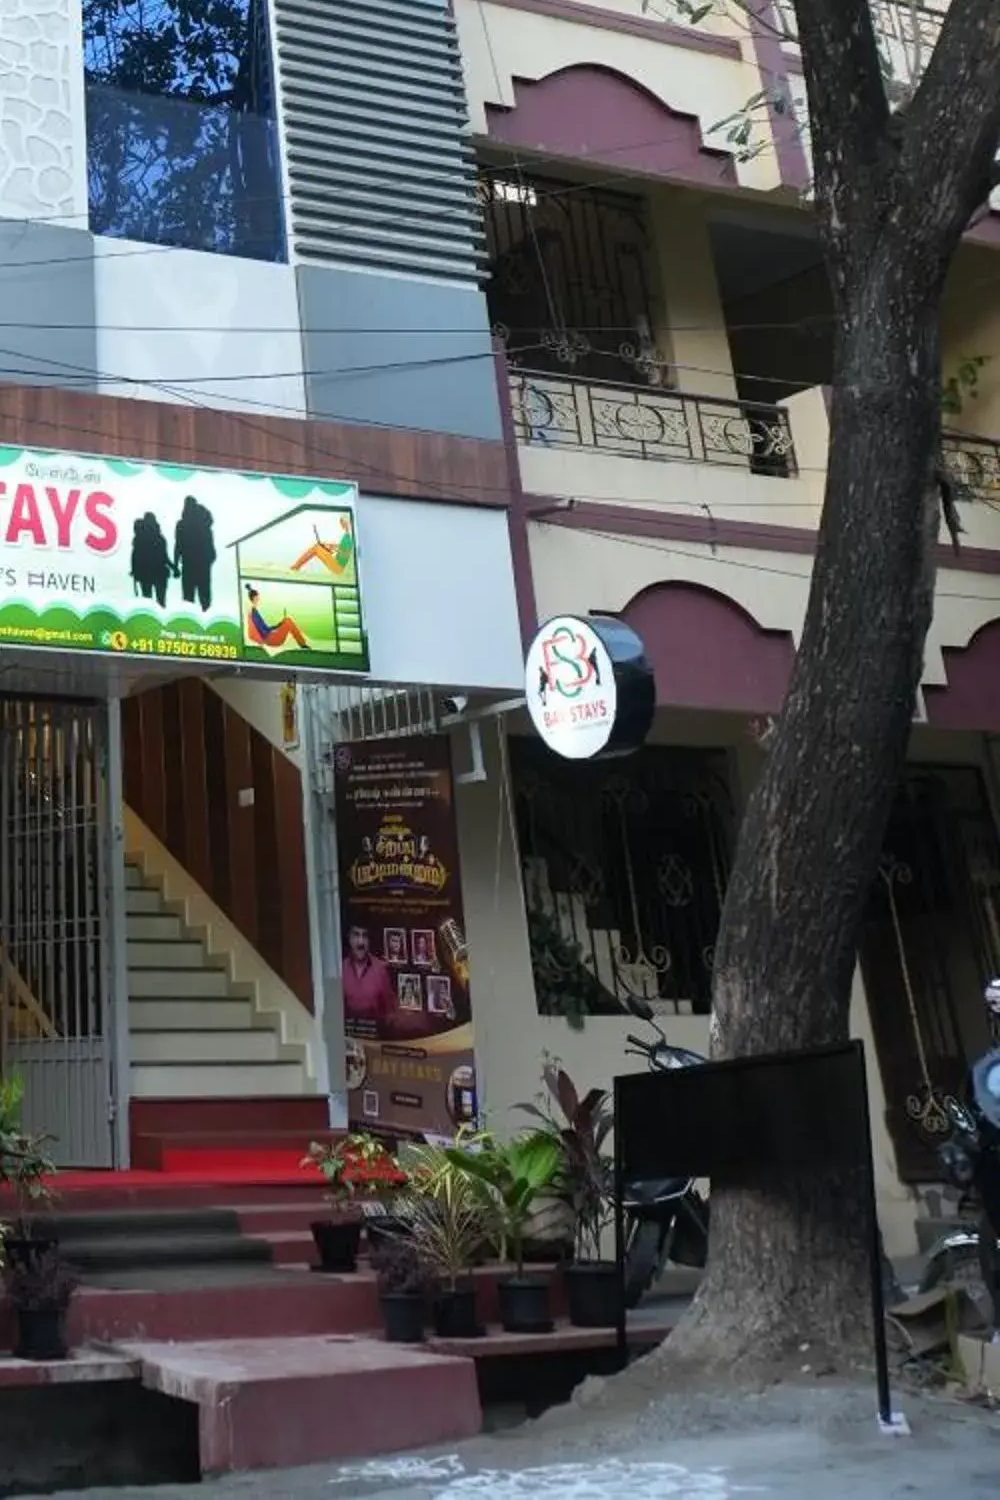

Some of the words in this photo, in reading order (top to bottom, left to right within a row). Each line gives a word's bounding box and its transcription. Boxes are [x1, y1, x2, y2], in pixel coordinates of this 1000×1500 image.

[28, 570, 95, 593] HAVEN
[130, 638, 153, 651] +91
[157, 639, 196, 654] 97502
[570, 700, 607, 722] STAYS
